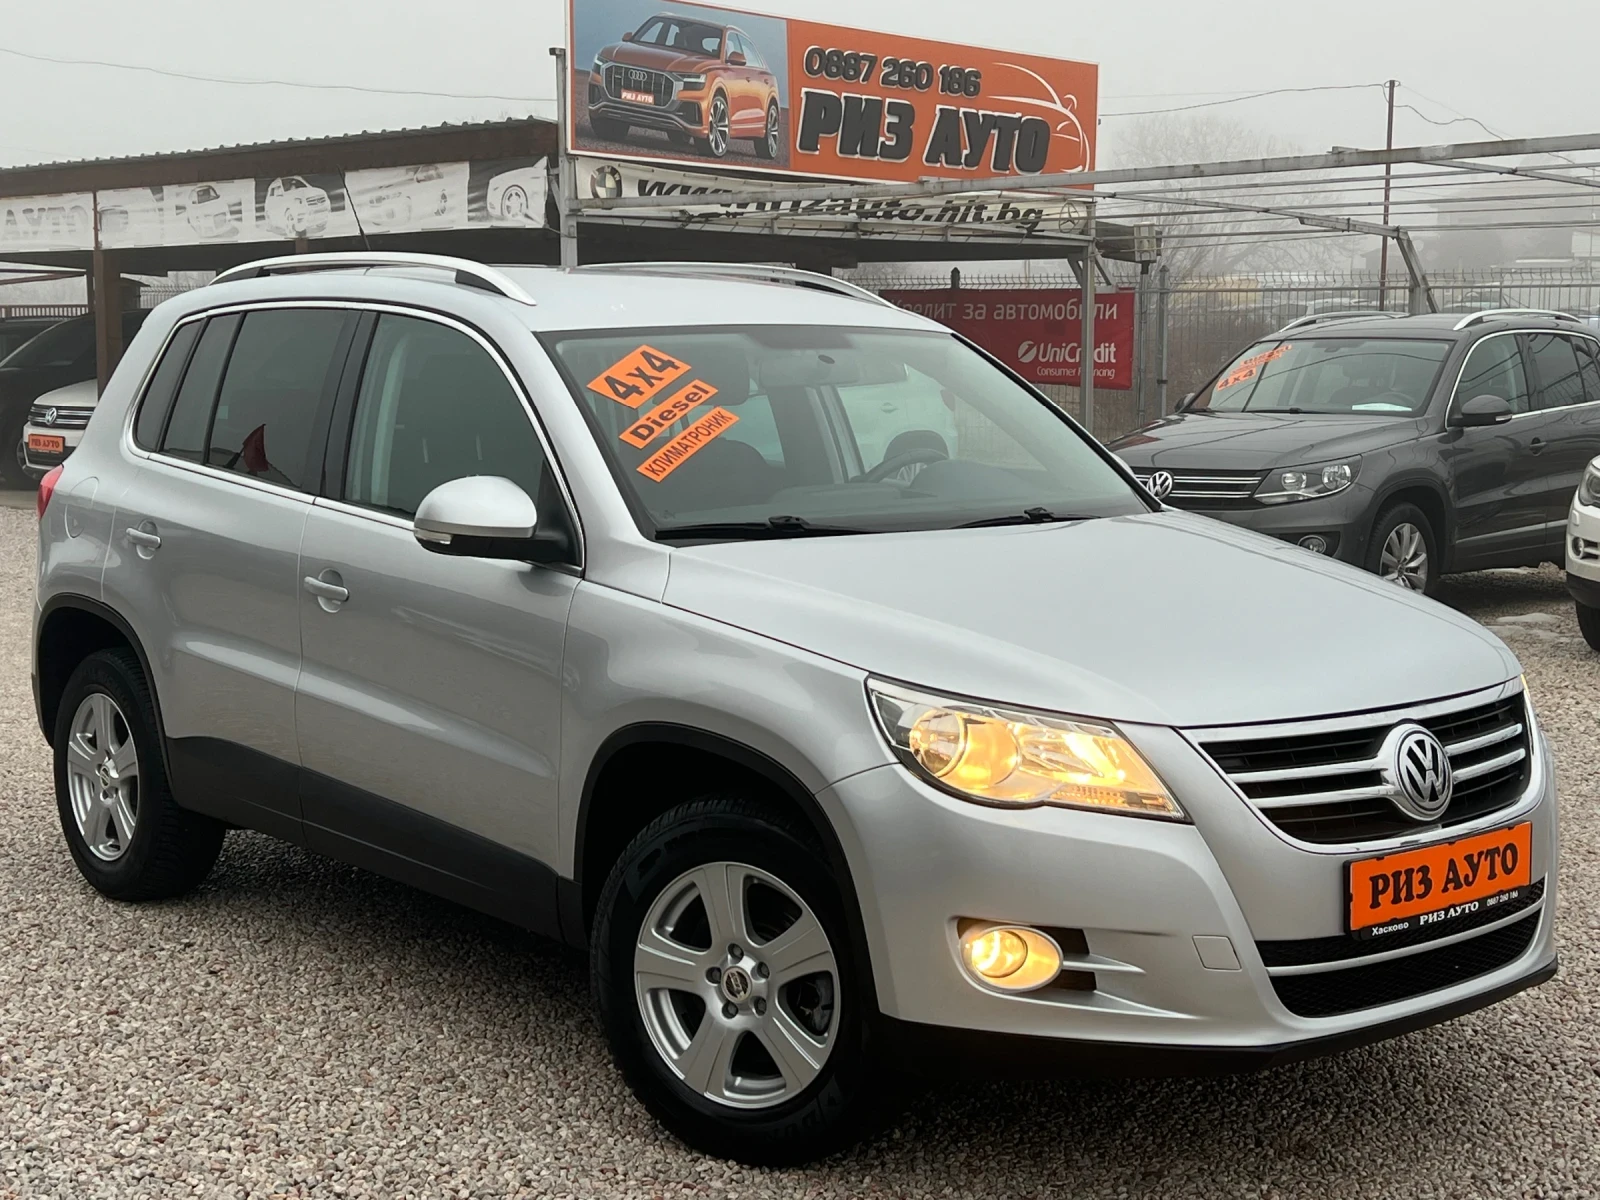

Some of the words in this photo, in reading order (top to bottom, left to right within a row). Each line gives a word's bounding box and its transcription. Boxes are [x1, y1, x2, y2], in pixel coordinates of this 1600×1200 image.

[804, 45, 878, 85] 0887
[880, 56, 934, 92] 260
[938, 64, 982, 98] 186
[796, 87, 915, 163] РИЗ
[922, 104, 1051, 175] АУТО
[962, 303, 986, 320] за
[993, 298, 1117, 320] автомобли
[1036, 366, 1077, 377] Consumer
[1038, 342, 1116, 363] UniCrdit
[629, 384, 710, 441] Diesel
[645, 411, 733, 477] КЛИМАТРОНИК
[1369, 865, 1433, 909] РИЗ
[1441, 843, 1518, 893] АУТО
[1372, 922, 1409, 936] Хасково
[1419, 911, 1445, 926] РИЗ
[1446, 901, 1480, 919] АУТО
